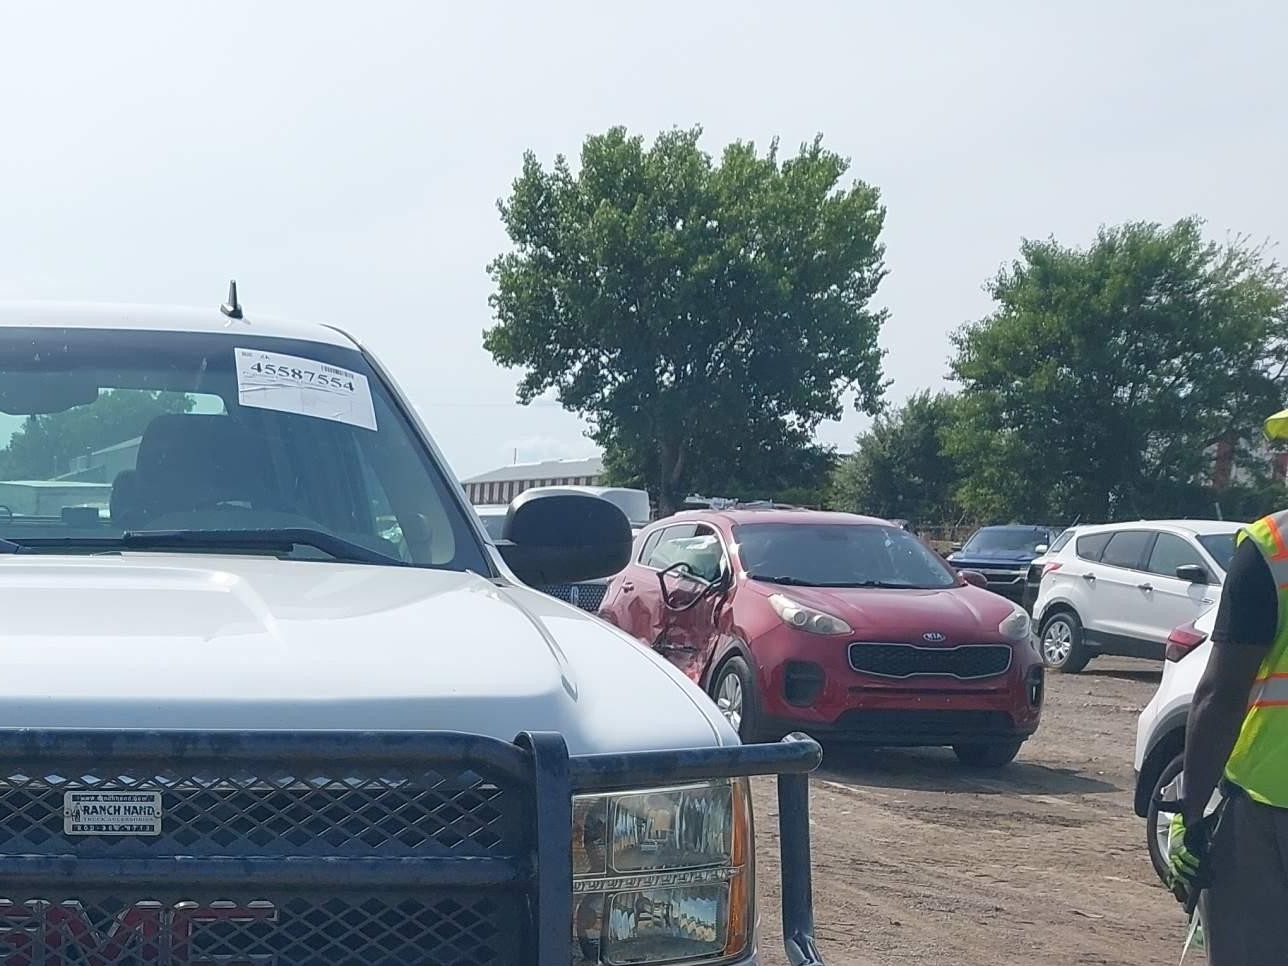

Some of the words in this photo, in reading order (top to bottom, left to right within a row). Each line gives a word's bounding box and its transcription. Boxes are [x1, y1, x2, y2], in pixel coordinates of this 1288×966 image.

[250, 361, 355, 392] 45587554
[83, 805, 121, 815] RANCH
[123, 805, 155, 816] HAND
